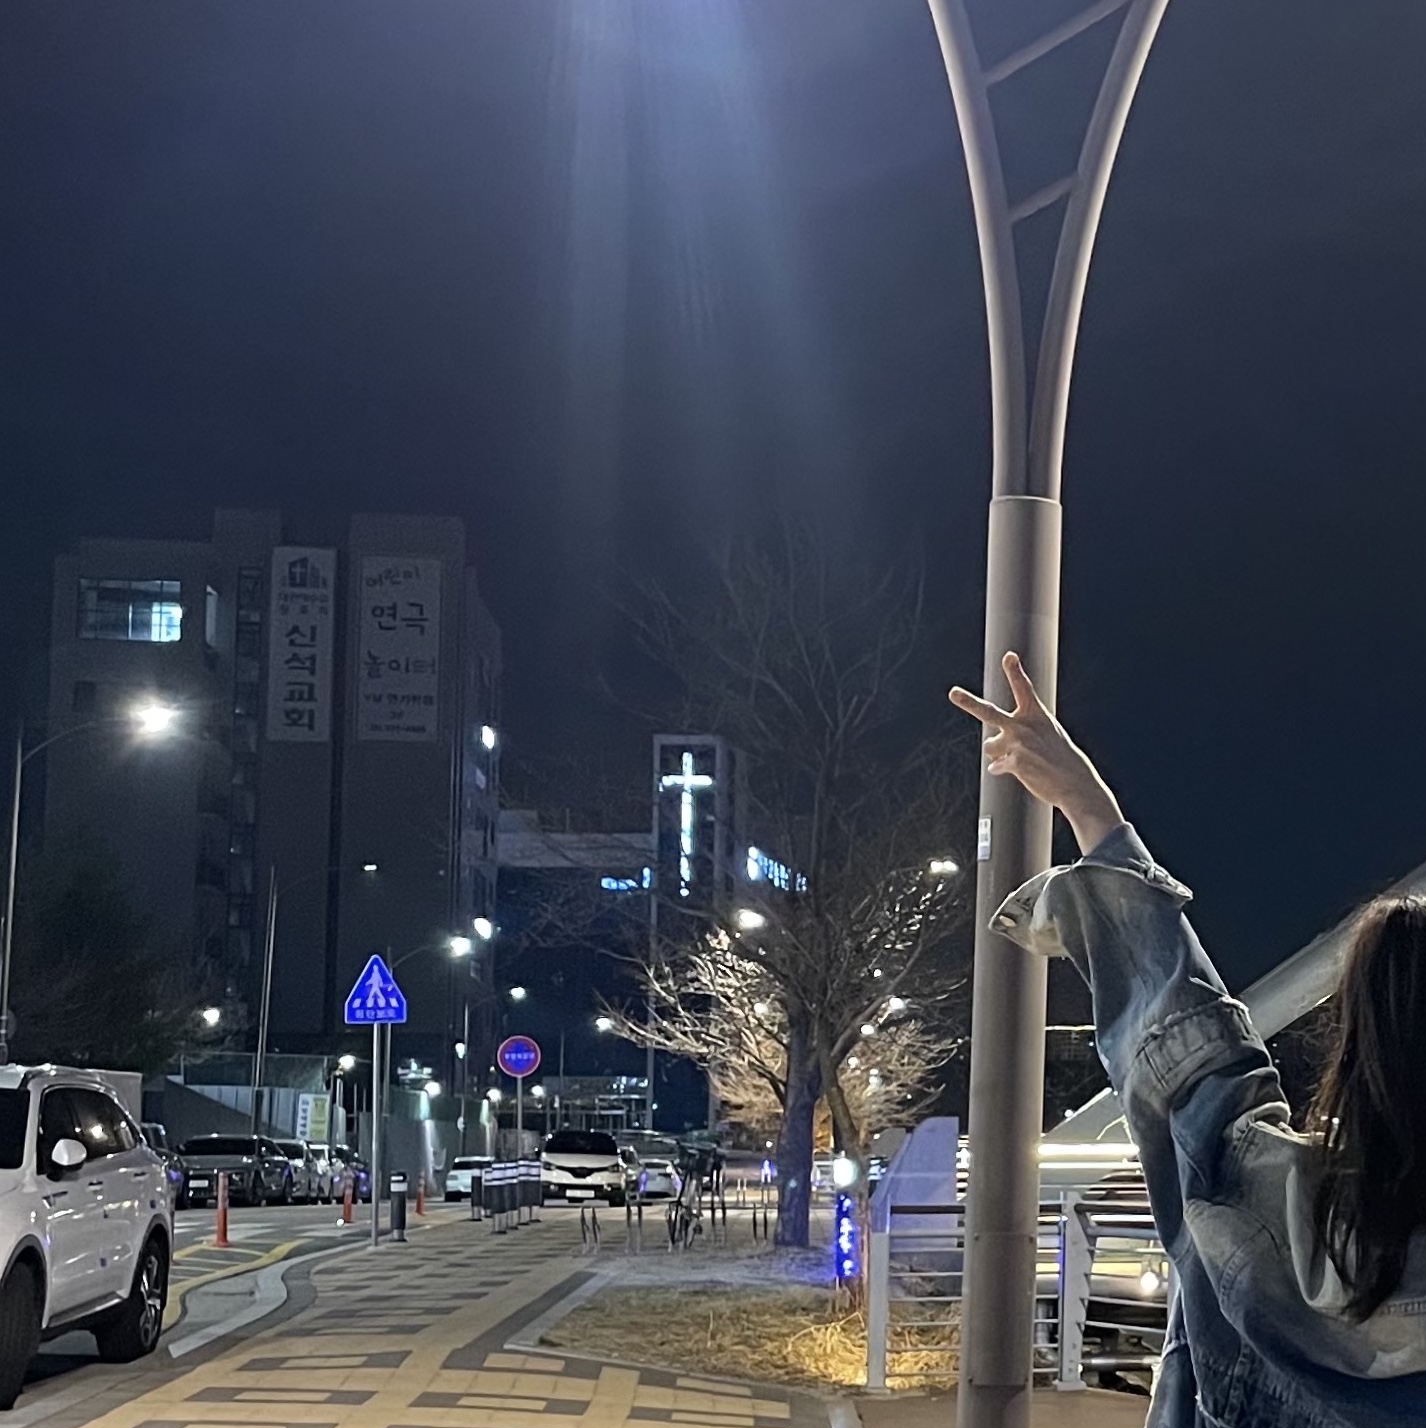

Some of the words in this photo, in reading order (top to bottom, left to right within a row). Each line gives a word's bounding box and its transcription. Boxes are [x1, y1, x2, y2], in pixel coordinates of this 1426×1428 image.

[371, 602, 429, 636] 연극
[282, 625, 318, 732] 신석교회
[364, 650, 436, 679] 놀이터
